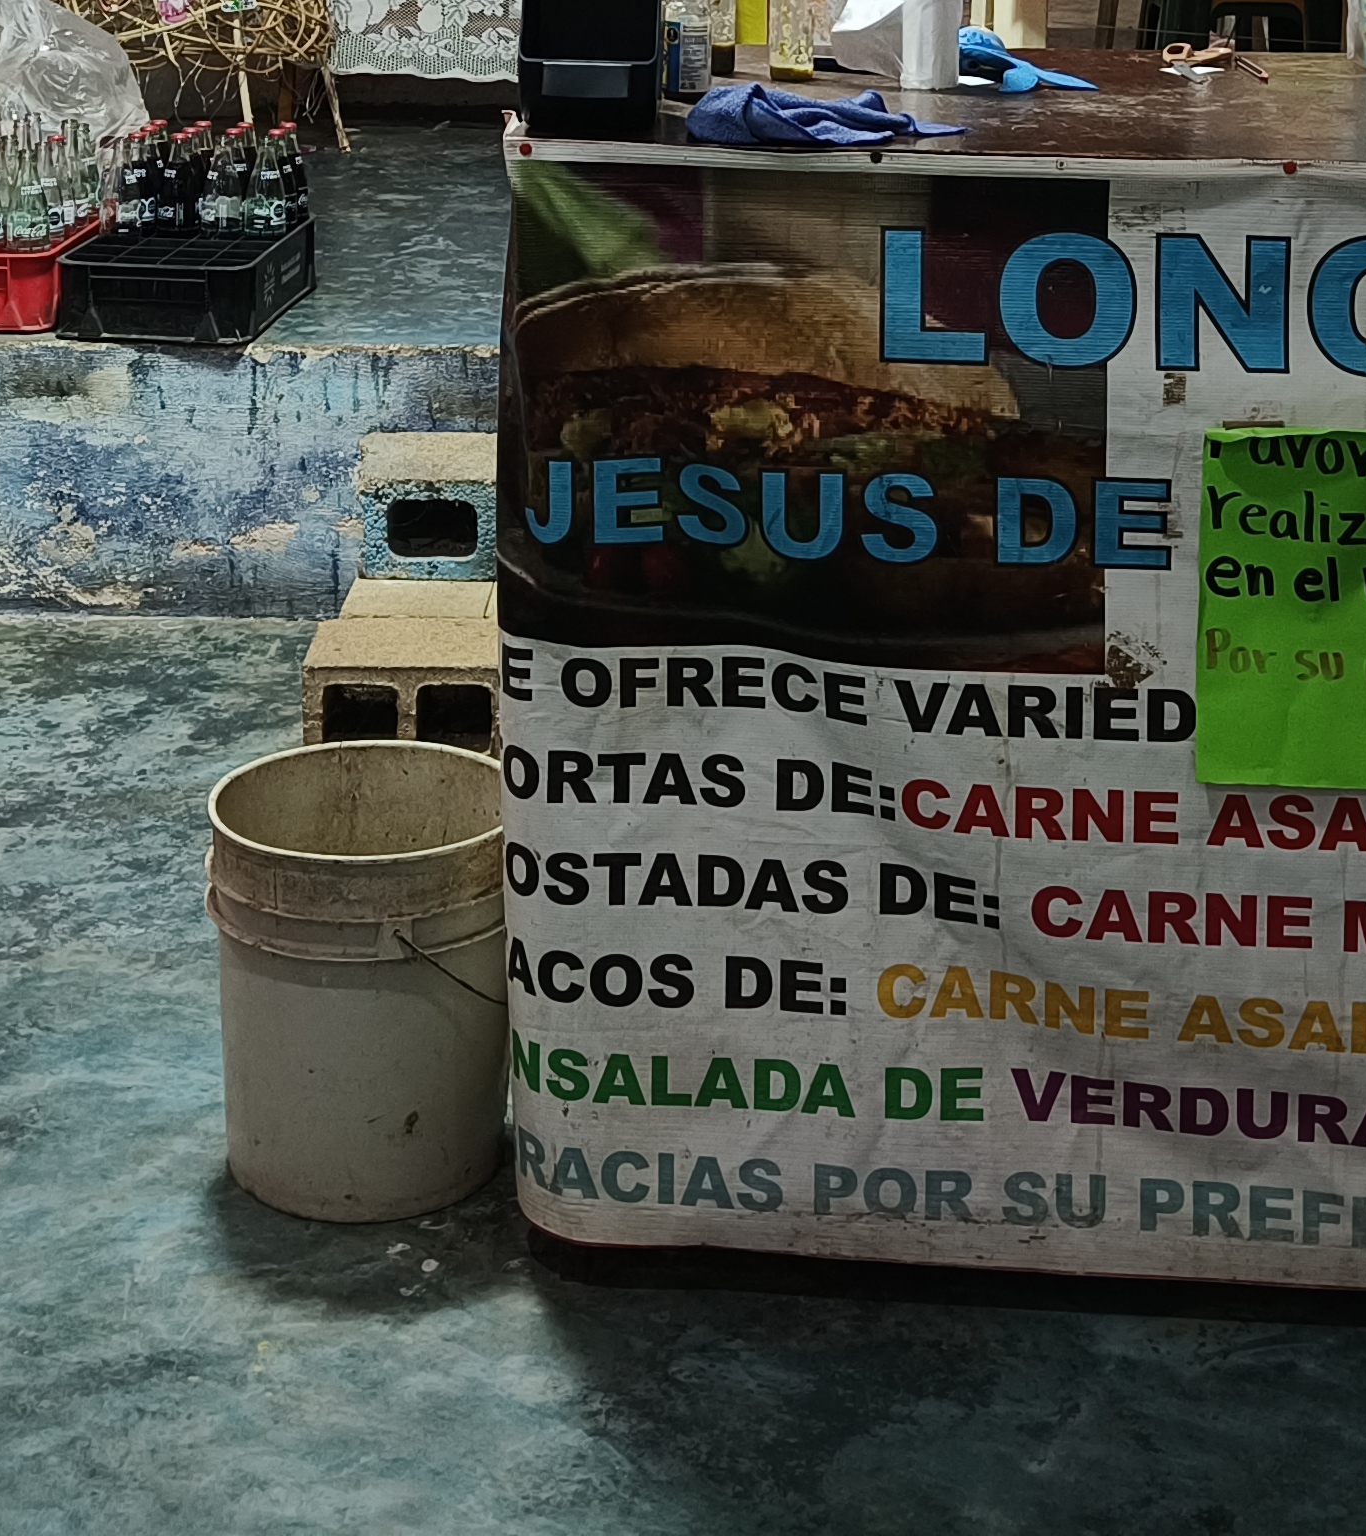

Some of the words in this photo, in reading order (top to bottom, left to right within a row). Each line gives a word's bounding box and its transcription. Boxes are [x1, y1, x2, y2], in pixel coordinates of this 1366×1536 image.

[524, 457, 937, 564] JESUS
[994, 474, 1173, 571] DE
[1205, 554, 1275, 597] en
[1292, 556, 1340, 603] el
[501, 642, 534, 702] E
[560, 655, 869, 727] OFRECE
[894, 679, 1197, 744] VARIED
[1205, 627, 1278, 674] Por
[1295, 648, 1345, 682] su
[502, 743, 747, 809] ORTAS
[504, 841, 849, 915] OSTADAS
[878, 861, 1001, 930] DE:
[1031, 885, 1314, 948] CARNE
[506, 936, 696, 1009] ACOS
[724, 954, 848, 1017] DE:
[876, 963, 1150, 1040] CARNE
[510, 1038, 856, 1120] NSALADA
[883, 1066, 984, 1122] DE
[515, 1124, 784, 1214] RACIAS
[813, 1161, 974, 1222] POR
[1002, 1172, 1108, 1229] SU
